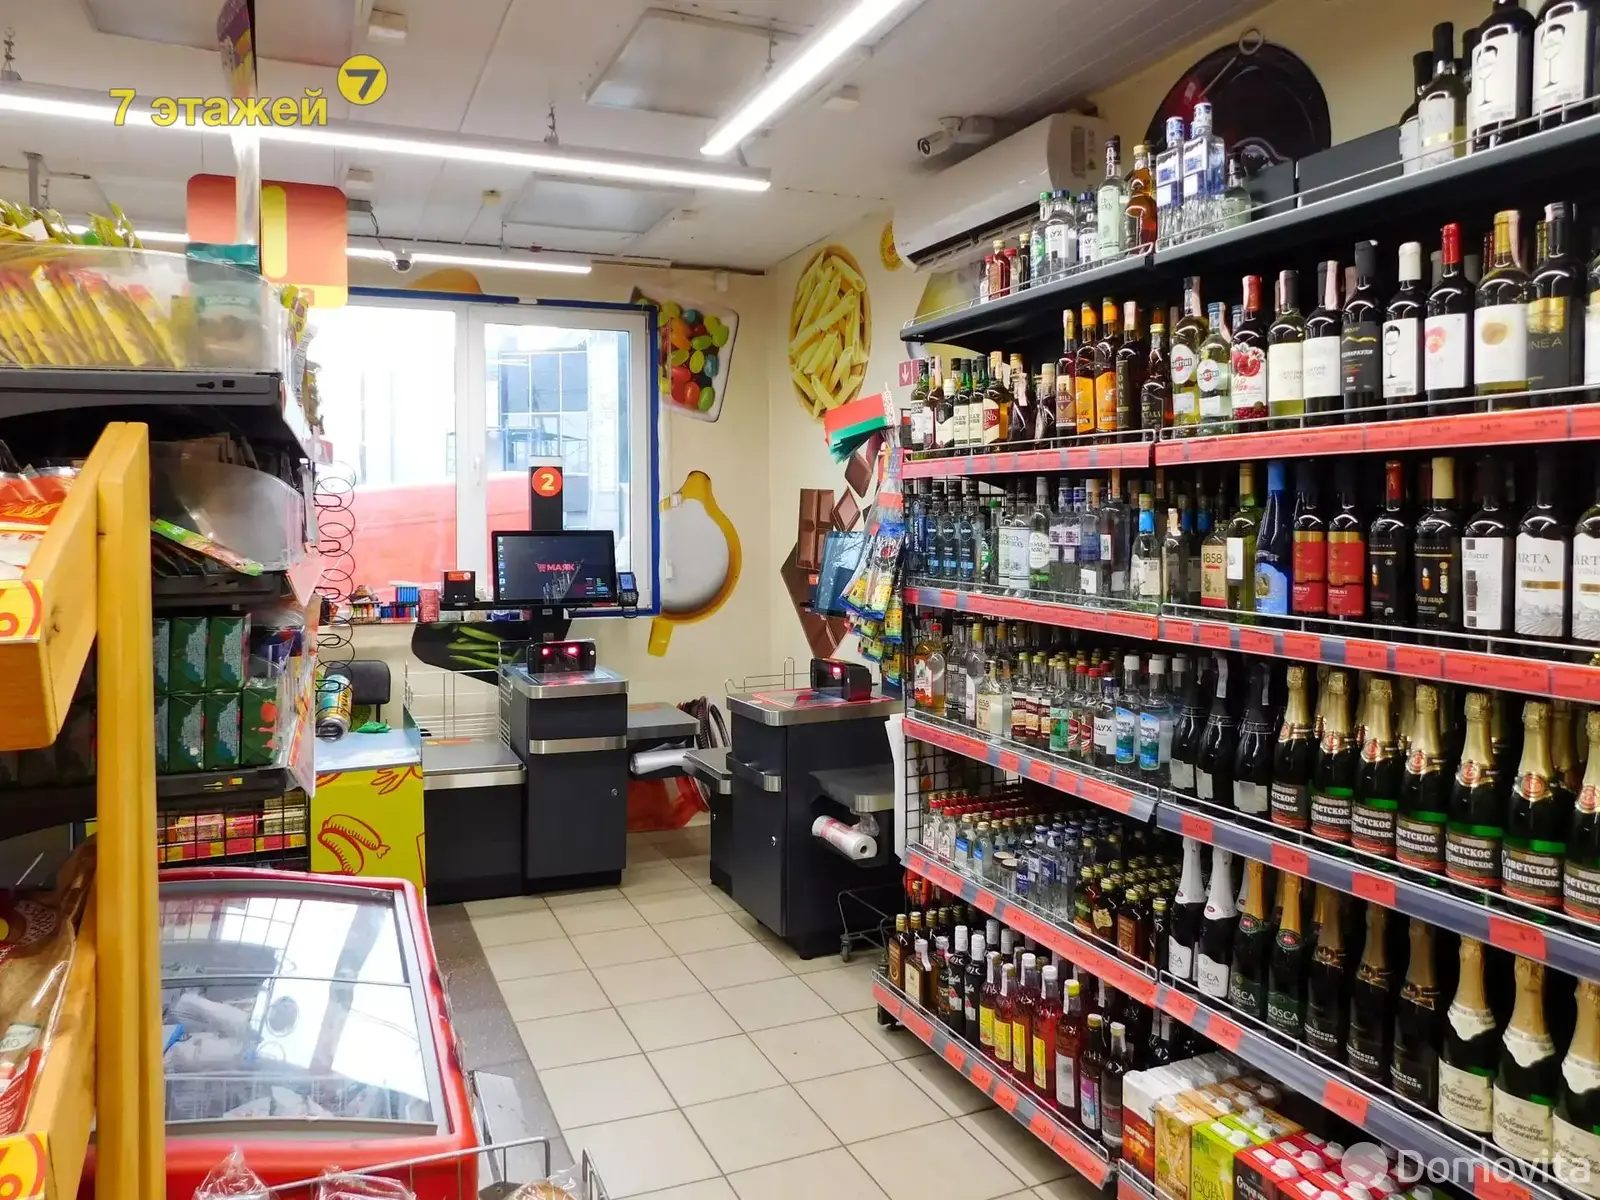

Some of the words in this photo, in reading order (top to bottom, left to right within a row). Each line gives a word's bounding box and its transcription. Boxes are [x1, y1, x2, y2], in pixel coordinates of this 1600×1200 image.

[541, 473, 555, 491] 2
[1203, 552, 1222, 564] 1858
[1501, 849, 1558, 877] Советское
